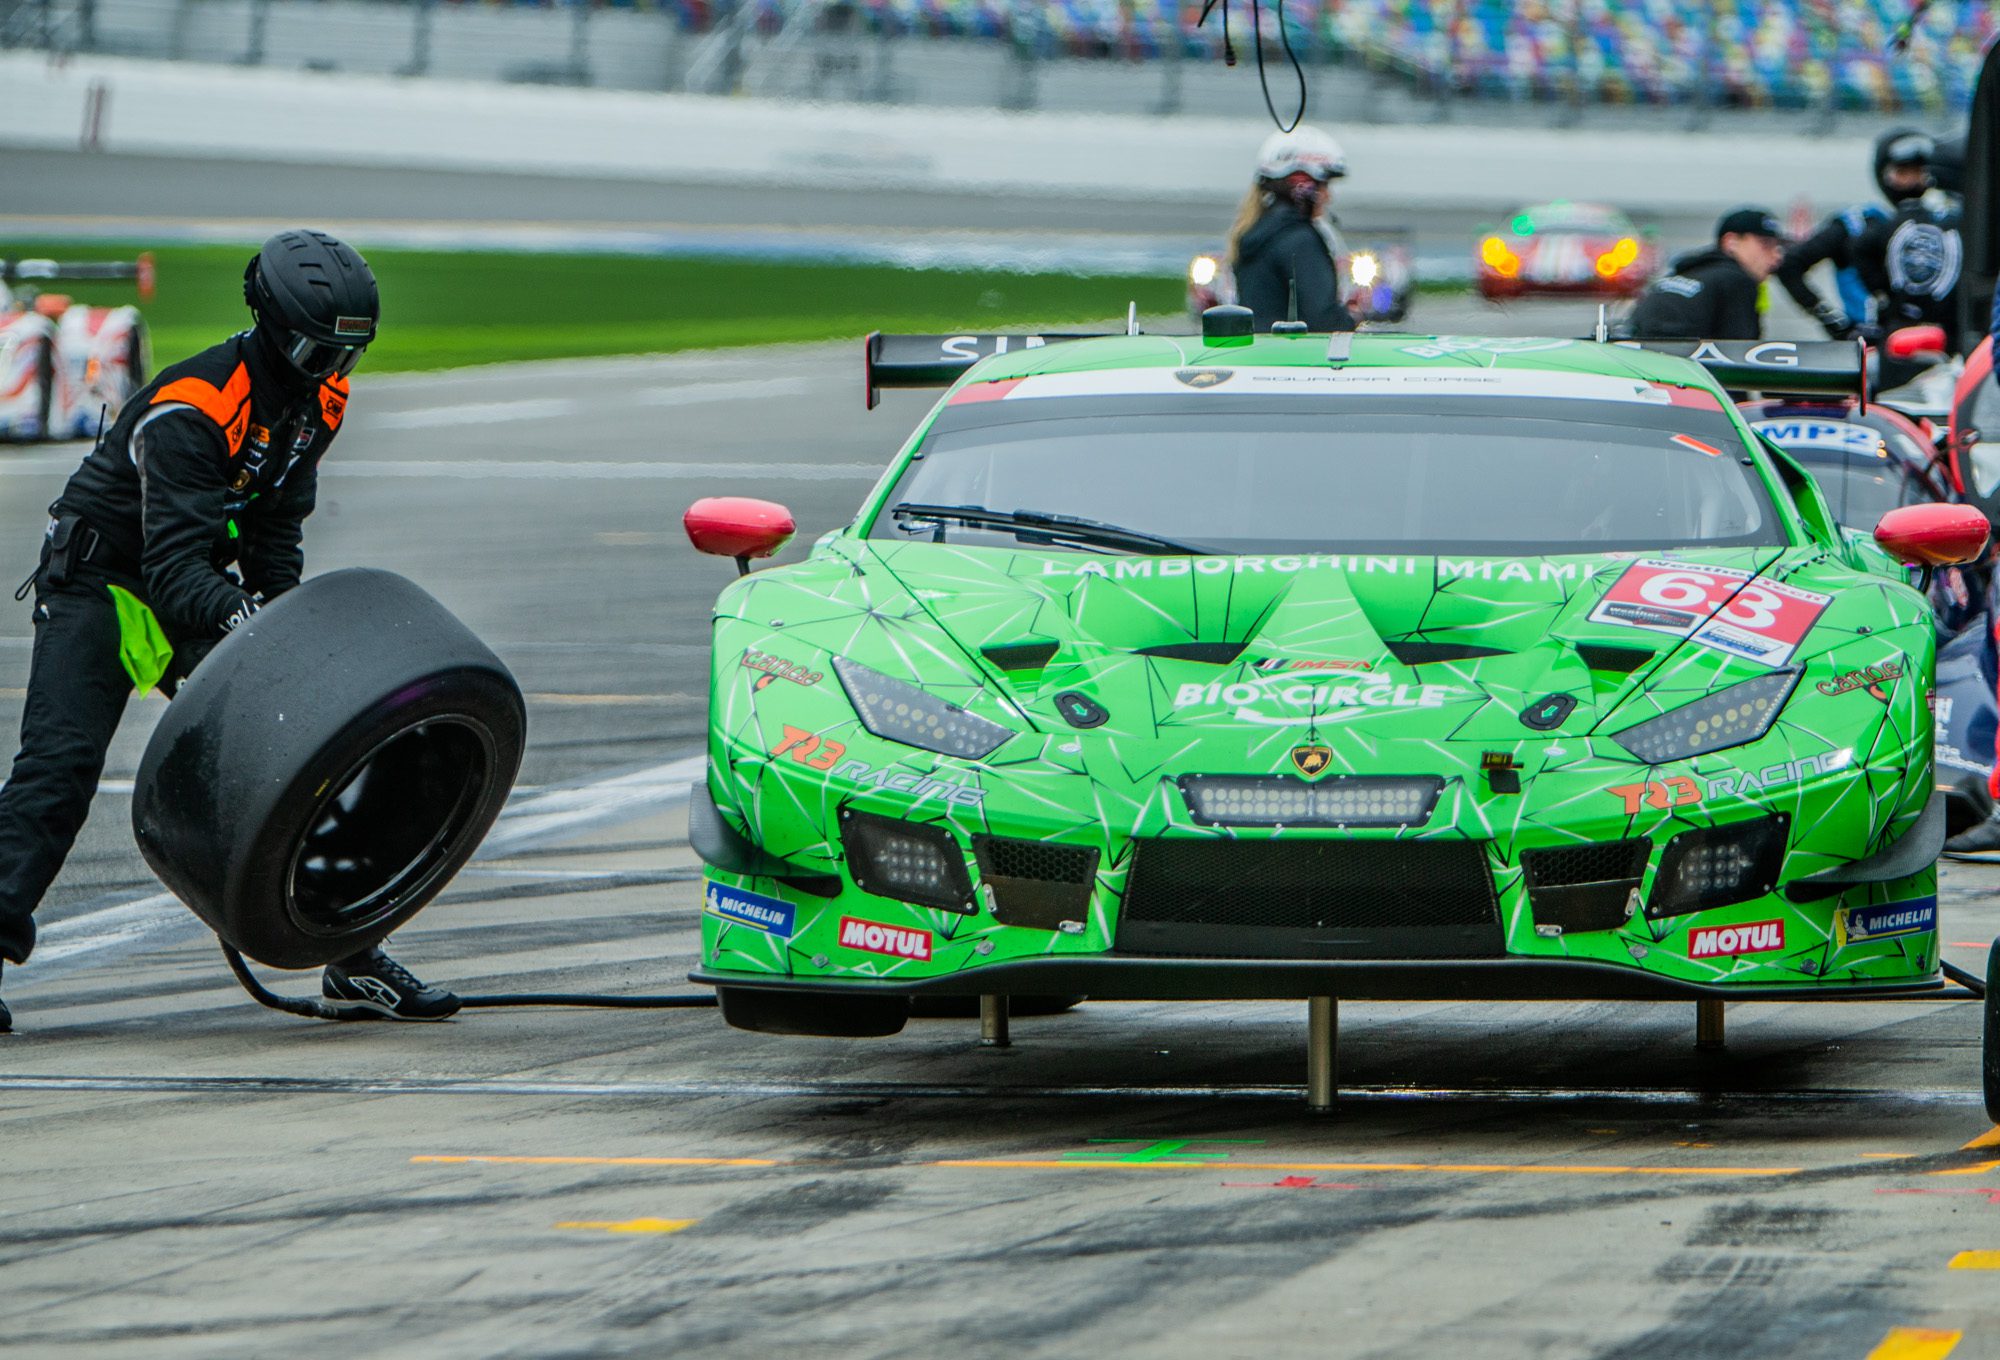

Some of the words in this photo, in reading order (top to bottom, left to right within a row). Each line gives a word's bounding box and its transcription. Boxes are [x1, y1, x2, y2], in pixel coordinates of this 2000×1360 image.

[1761, 423, 1869, 446] MP2
[1043, 555, 1415, 578] LAMBORGHINI
[1437, 558, 1593, 582] MIAMI
[1640, 571, 1784, 628] 63
[1291, 660, 1372, 670] IMSA
[1174, 682, 1448, 707] BIO-CIRCLE
[770, 724, 847, 770] TR3
[832, 759, 989, 807] RACING
[1603, 775, 1703, 816] TR3
[720, 895, 786, 925] MICHELIN
[1869, 907, 1933, 931] MICHELIN
[842, 921, 929, 957] MOTUL
[1692, 923, 1782, 955] MOTUL
